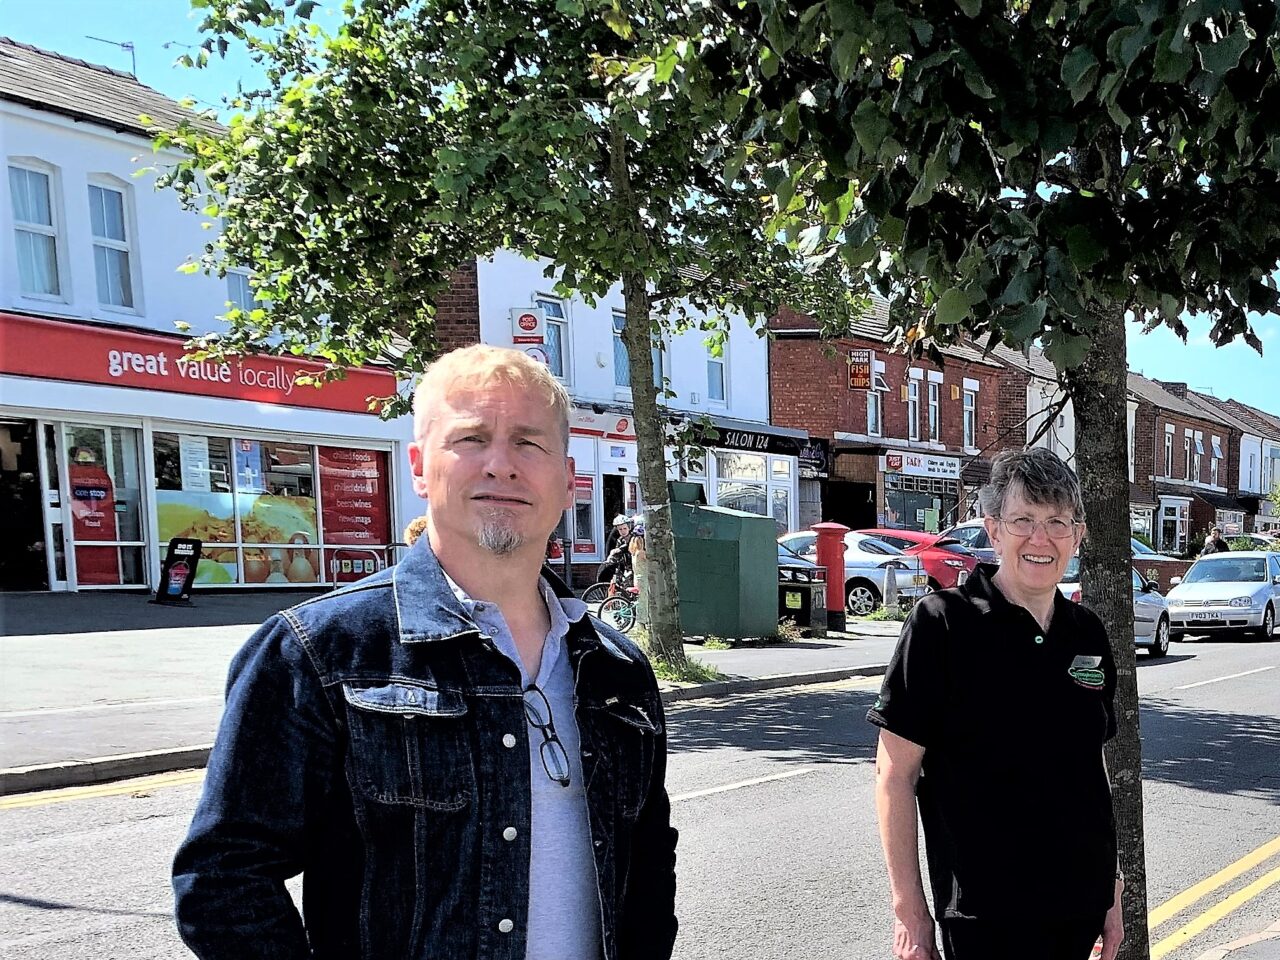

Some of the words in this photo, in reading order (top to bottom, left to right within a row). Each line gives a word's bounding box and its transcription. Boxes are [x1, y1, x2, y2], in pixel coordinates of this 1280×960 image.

[108, 350, 169, 377] great
[175, 355, 232, 383] value
[238, 363, 296, 396] locally
[851, 364, 870, 374] FISH
[850, 377, 870, 387] CHIPS
[724, 432, 754, 447] SALON
[755, 436, 770, 450] 124
